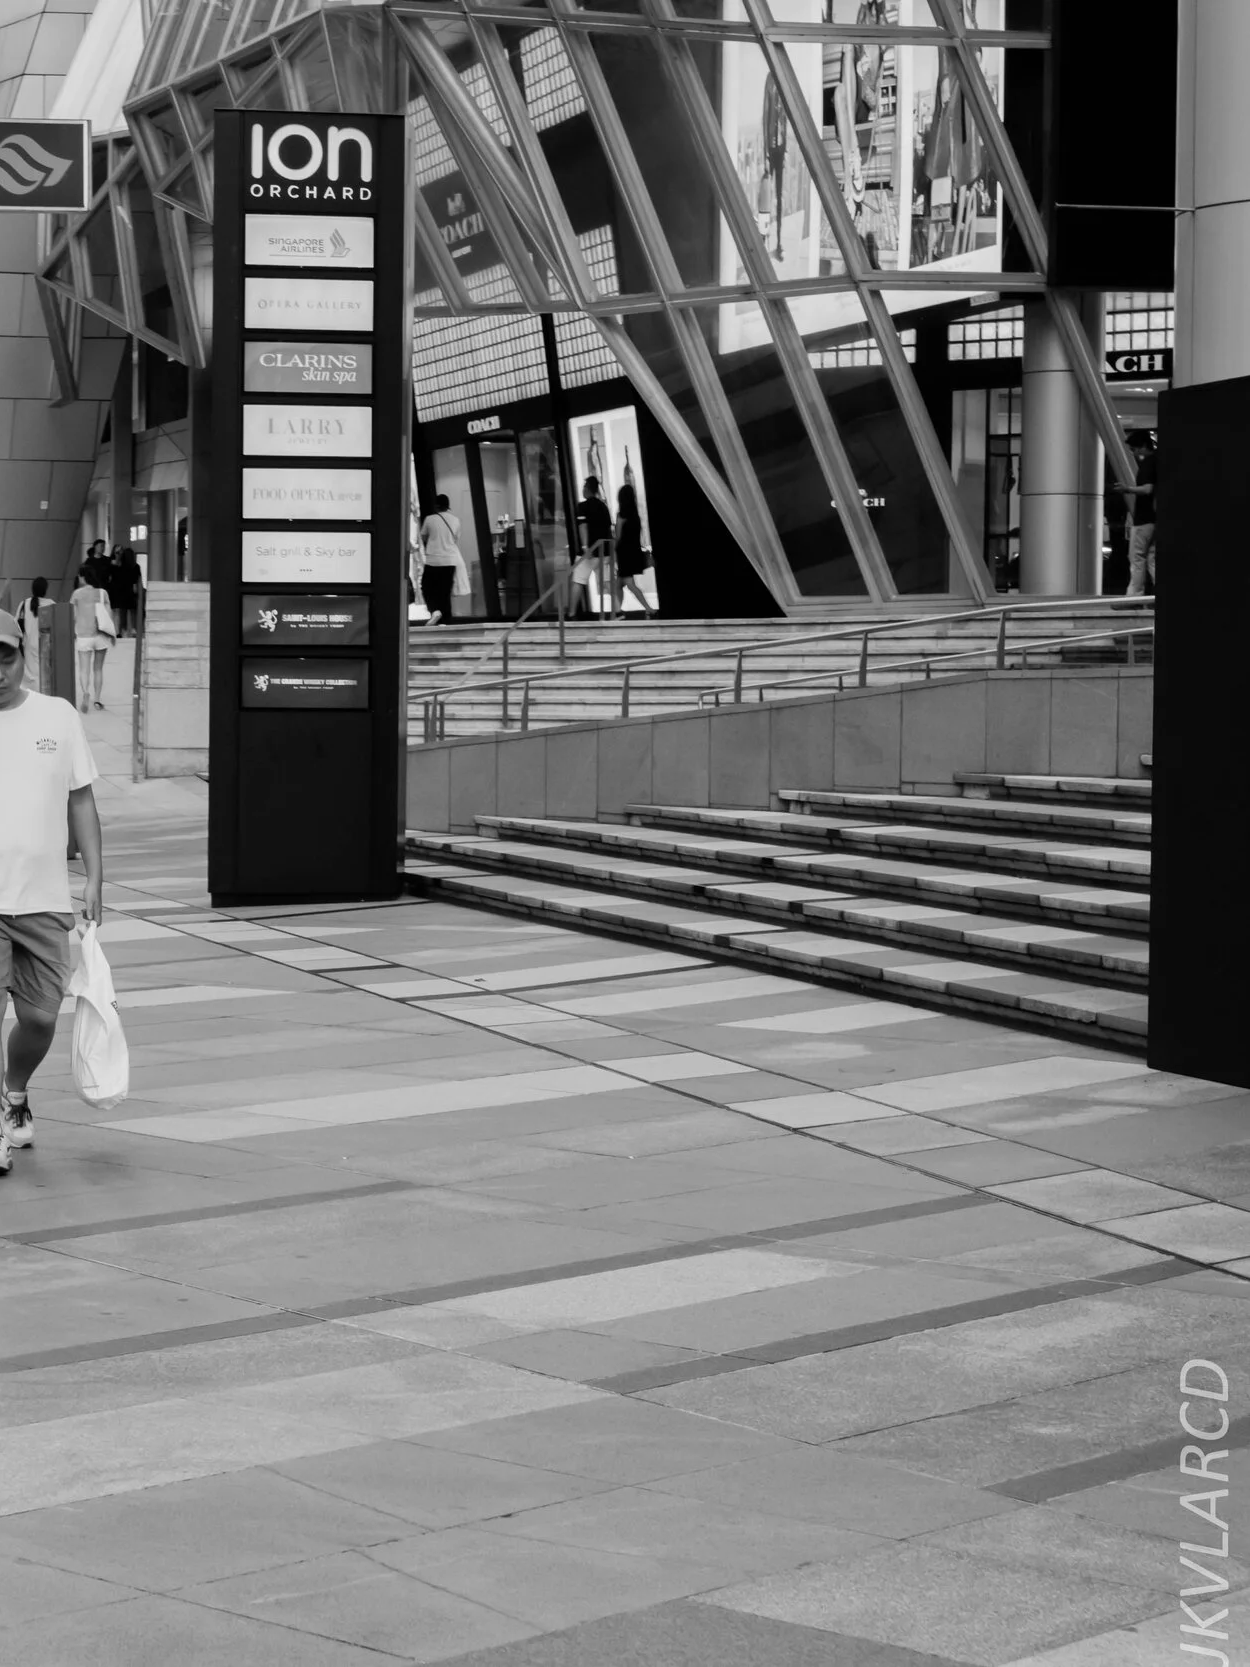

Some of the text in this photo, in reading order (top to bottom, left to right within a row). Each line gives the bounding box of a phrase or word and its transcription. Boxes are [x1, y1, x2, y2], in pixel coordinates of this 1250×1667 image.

[250, 184, 372, 200] ORCHARD
[439, 211, 485, 245] OACH
[268, 237, 325, 246] SINGAPORE
[281, 245, 325, 254] AIRLINES
[306, 300, 362, 310] GALLERY
[259, 353, 357, 369] CLARINS
[301, 367, 357, 385] skin spa
[268, 418, 346, 435] LARRY
[252, 488, 287, 501] FOOD
[290, 488, 335, 501] OPERA
[255, 546, 277, 557] Salt
[303, 547, 312, 557] &
[315, 547, 336, 559] Sky
[338, 547, 358, 557] bar
